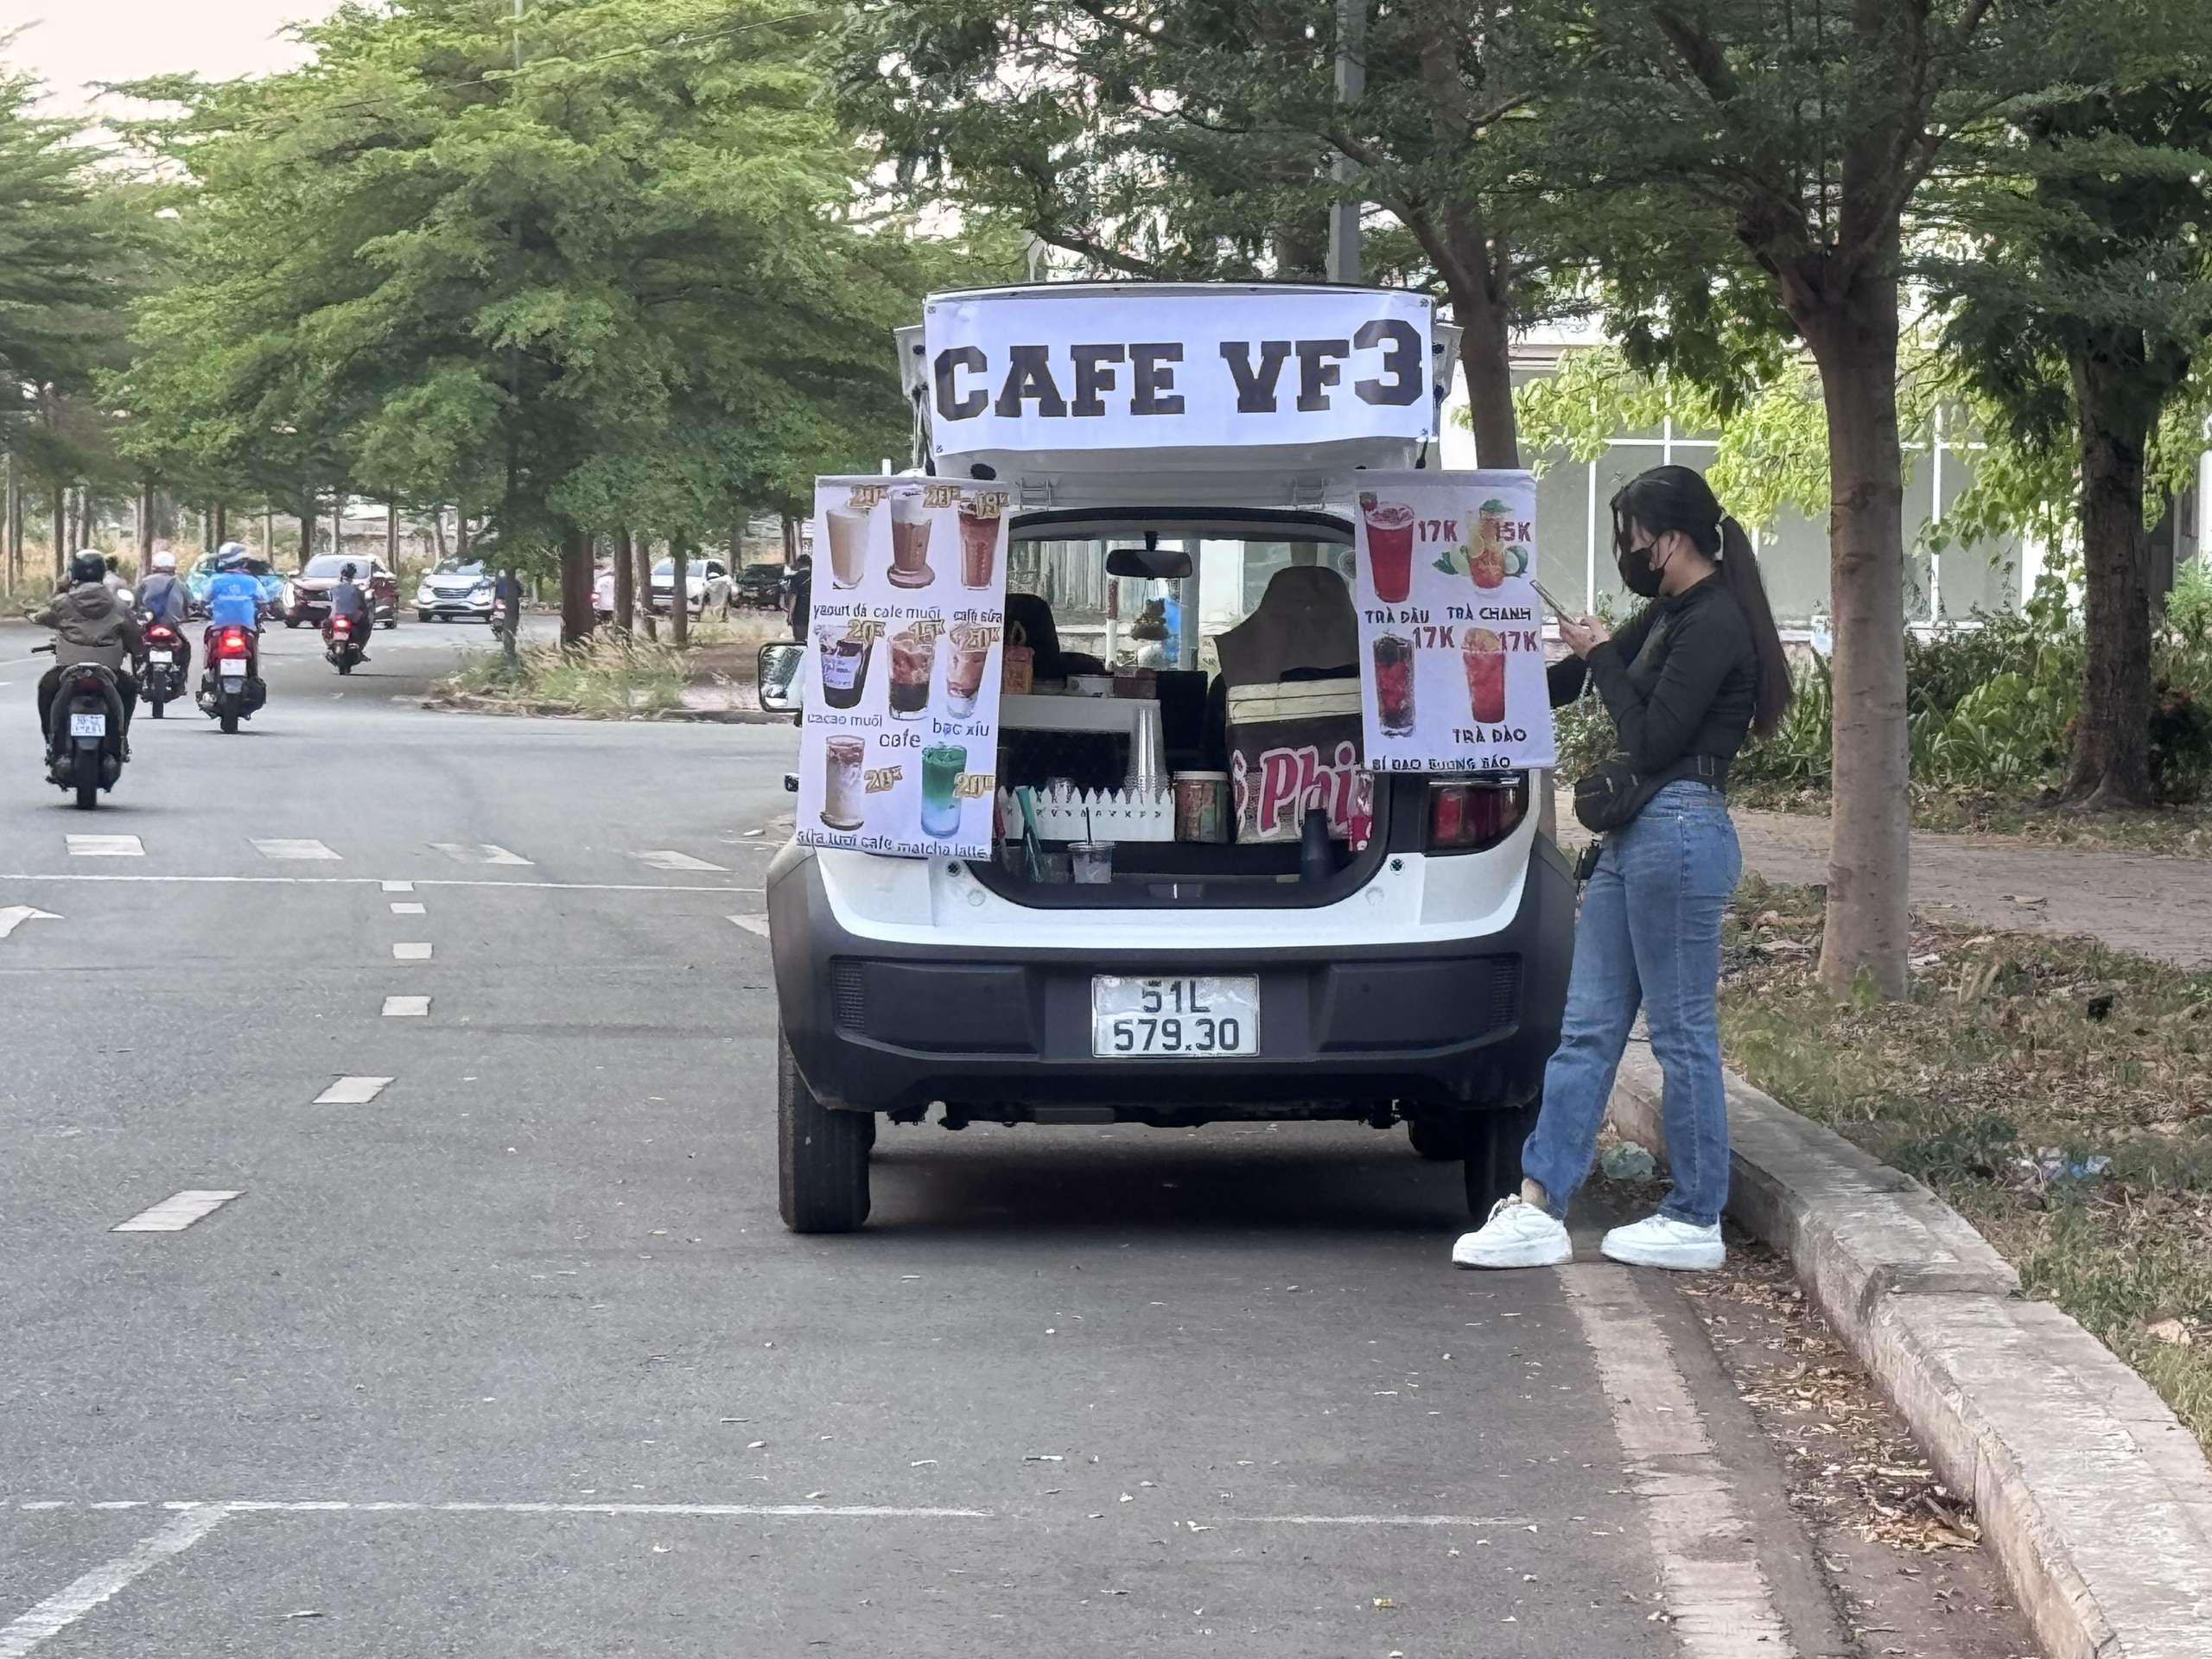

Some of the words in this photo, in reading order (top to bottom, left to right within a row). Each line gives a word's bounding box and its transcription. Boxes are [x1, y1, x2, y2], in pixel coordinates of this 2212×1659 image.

[934, 343, 1185, 421] CAFE
[1219, 319, 1423, 414] VF3
[1418, 520, 1458, 543] 17K
[1364, 606, 1395, 624] TRÀ
[1446, 603, 1475, 620] TRÀ
[1479, 607, 1532, 621] CHANH
[1413, 626, 1455, 650] 17K
[1499, 631, 1539, 652] 17K
[807, 713, 848, 725] cacao
[1452, 727, 1486, 743] TRÀ
[1141, 979, 1211, 1014] 51L
[1113, 1018, 1240, 1052] 579.30
